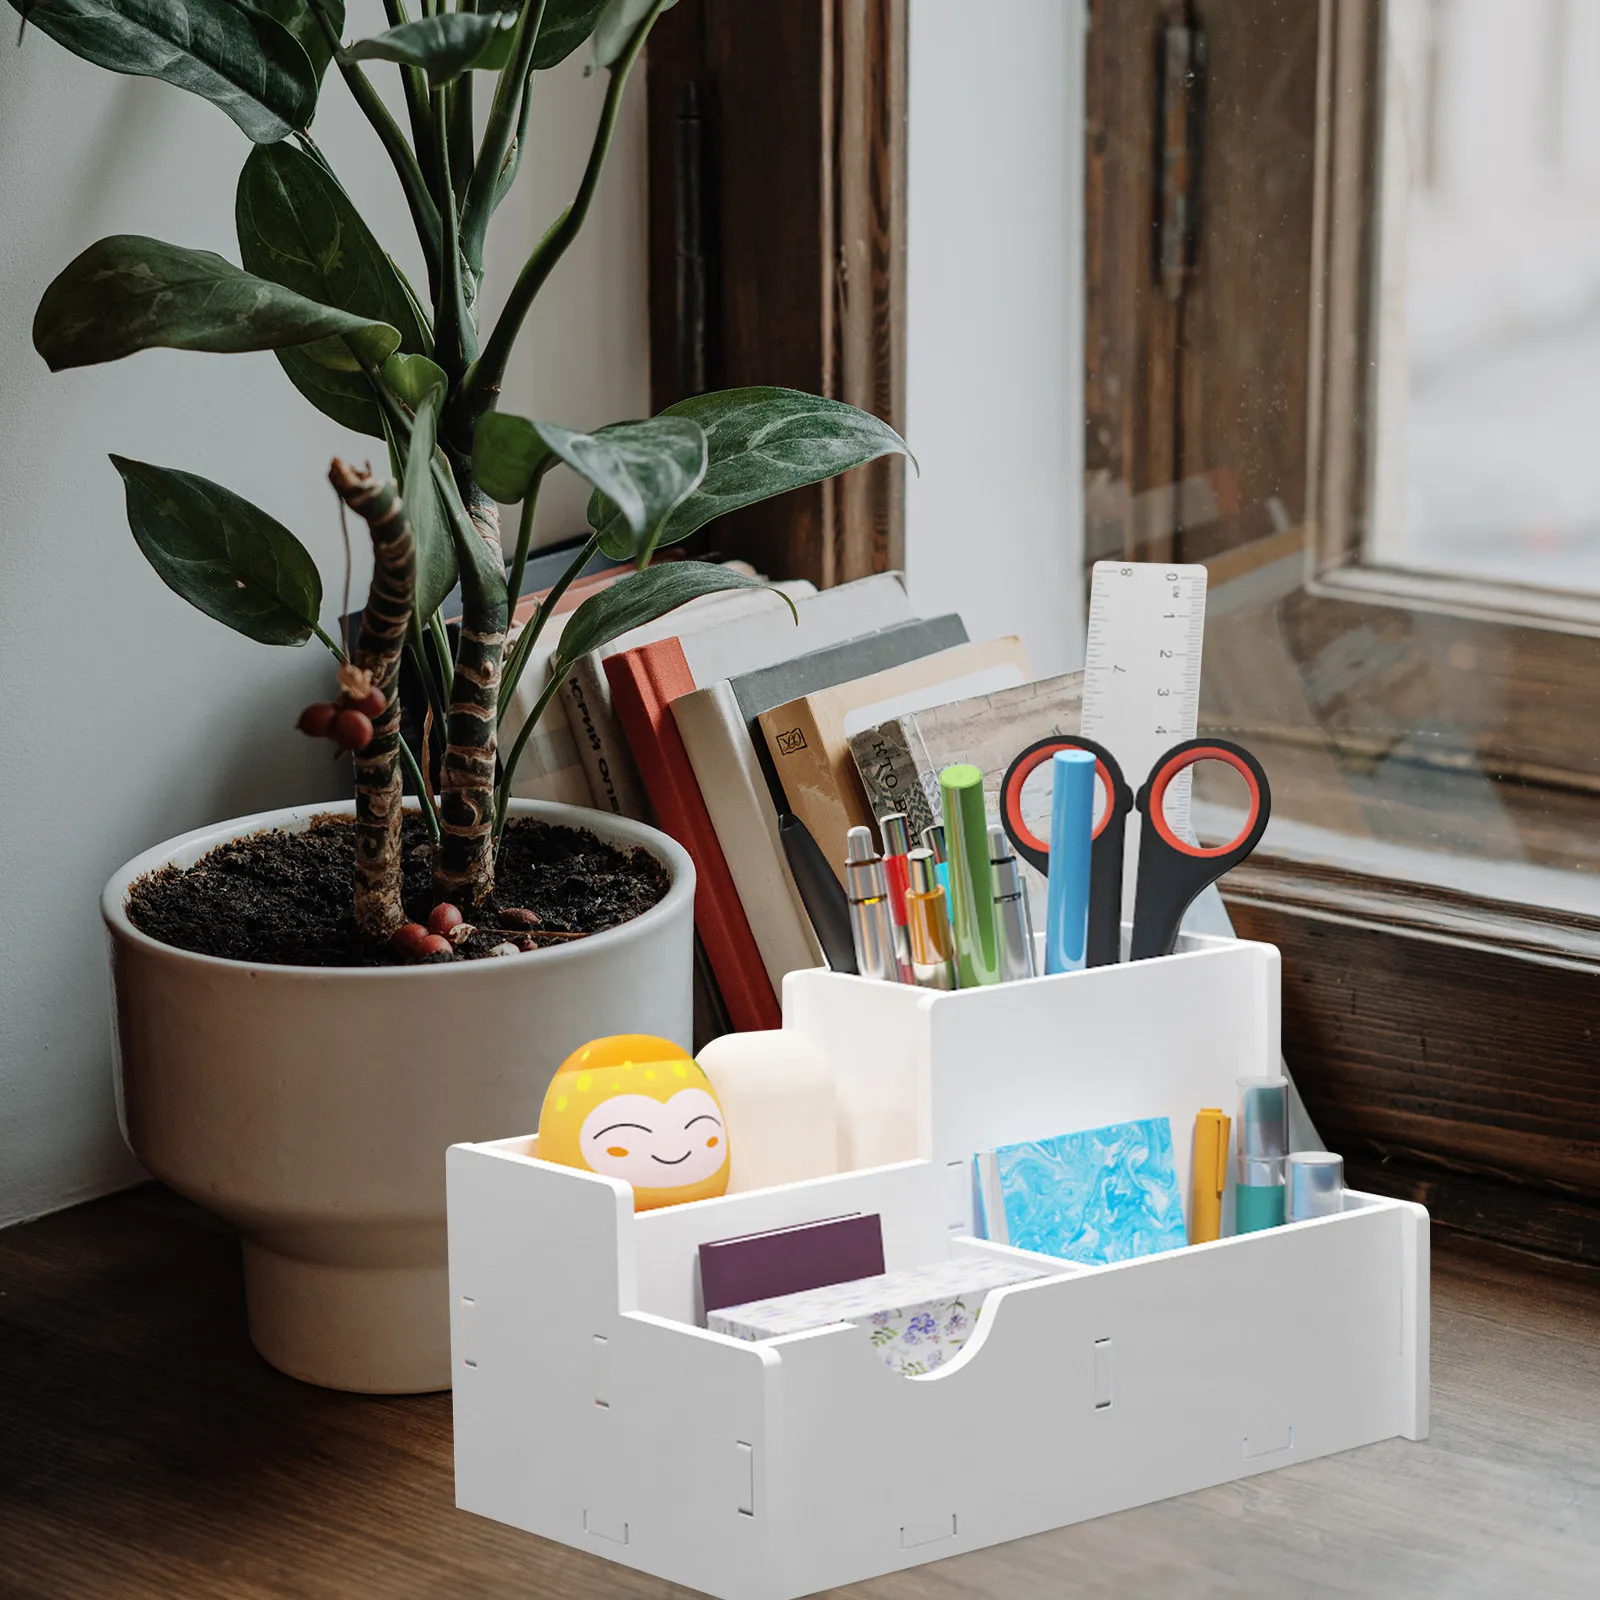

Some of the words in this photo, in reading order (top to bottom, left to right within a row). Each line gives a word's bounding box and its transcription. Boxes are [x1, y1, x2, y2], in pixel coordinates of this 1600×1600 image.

[1120, 568, 1133, 577] 8
[1165, 573, 1179, 582] 0
[1160, 649, 1173, 658] 2
[1112, 664, 1126, 674] 7
[1157, 688, 1170, 697] 3
[1154, 725, 1167, 735] 4
[569, 677, 601, 750] ЮРИЙ
[599, 757, 621, 816] ОЛЕ
[872, 740, 898, 788] КТО
